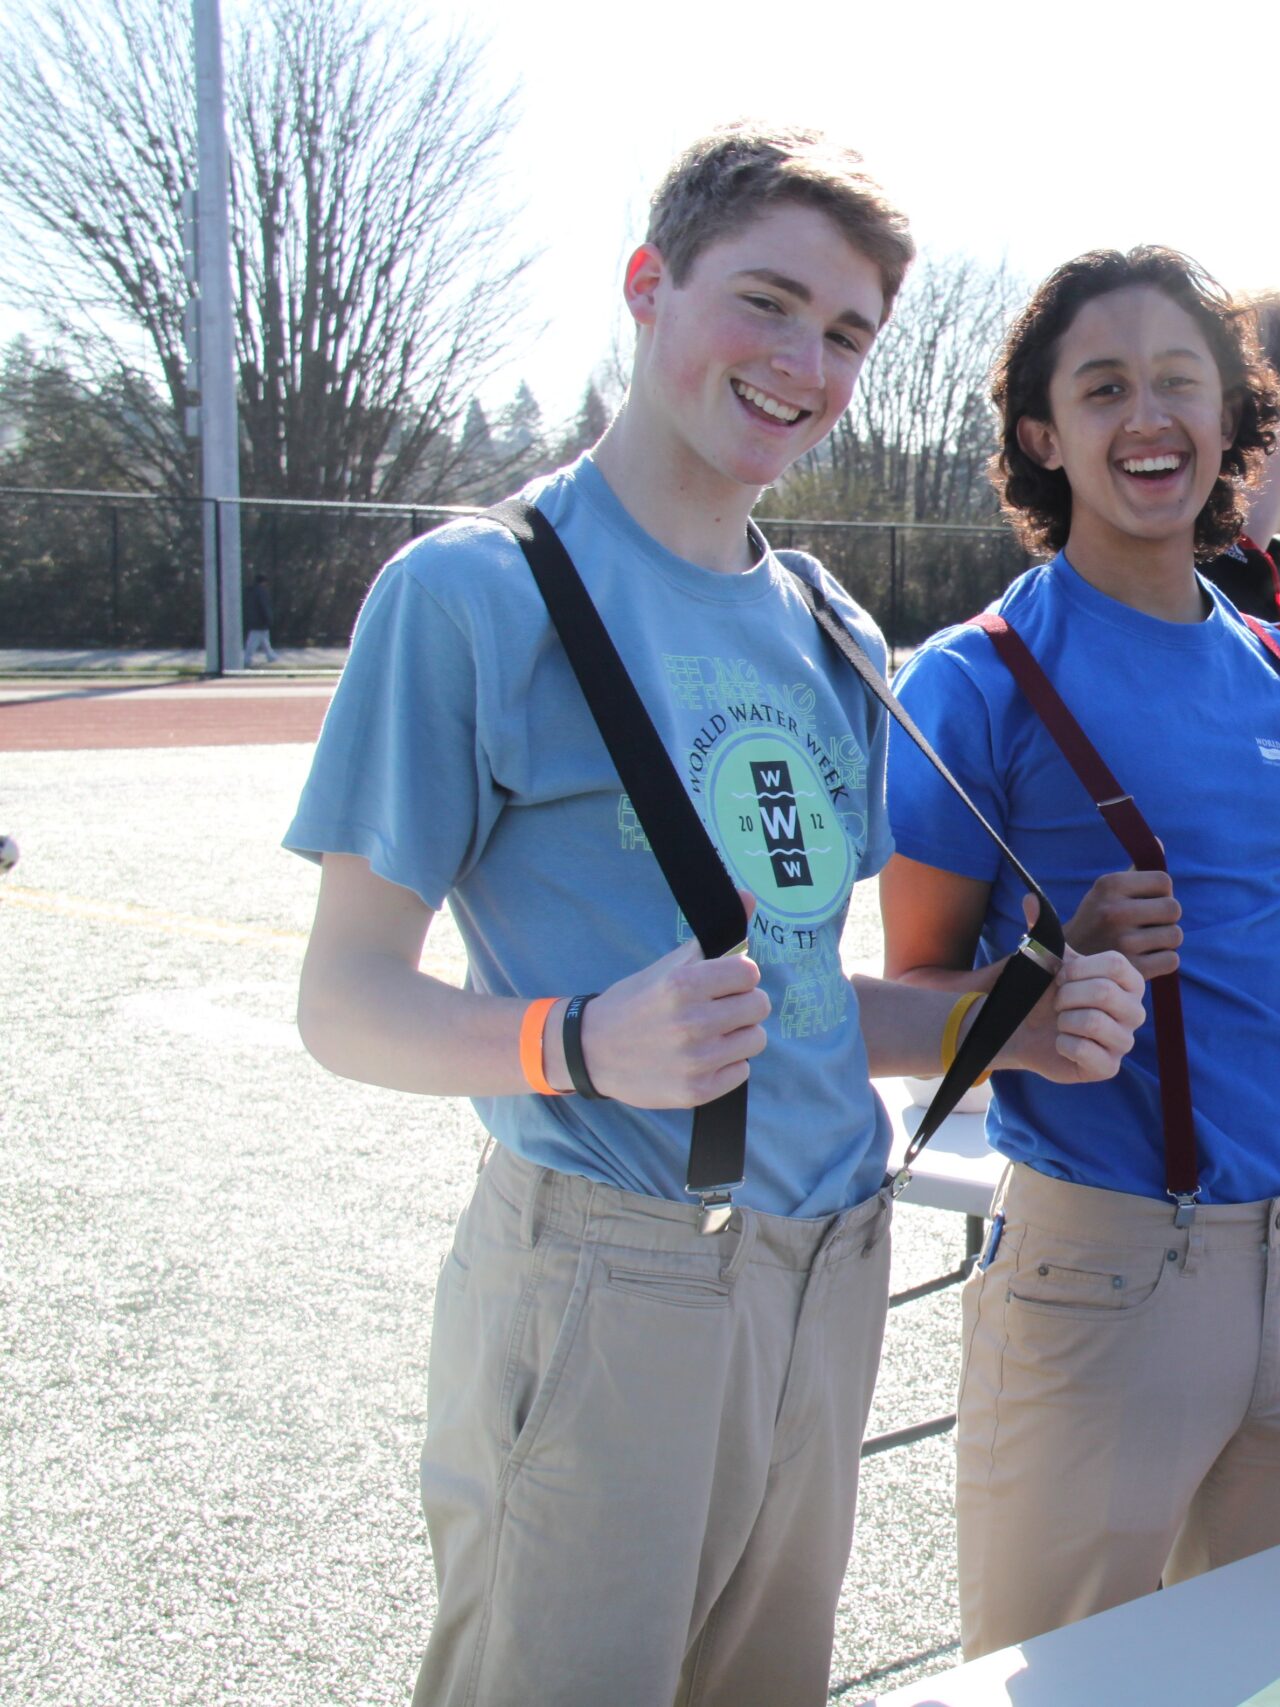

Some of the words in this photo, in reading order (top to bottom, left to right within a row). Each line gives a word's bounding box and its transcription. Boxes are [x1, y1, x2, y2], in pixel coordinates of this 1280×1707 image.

[688, 714, 727, 793] WORLD
[728, 704, 799, 736] WATER
[806, 733, 849, 805] WEEK
[760, 770, 780, 787] W
[739, 815, 753, 832] 20
[760, 805, 797, 840] W
[810, 813, 824, 830] 12
[782, 861, 801, 878] W
